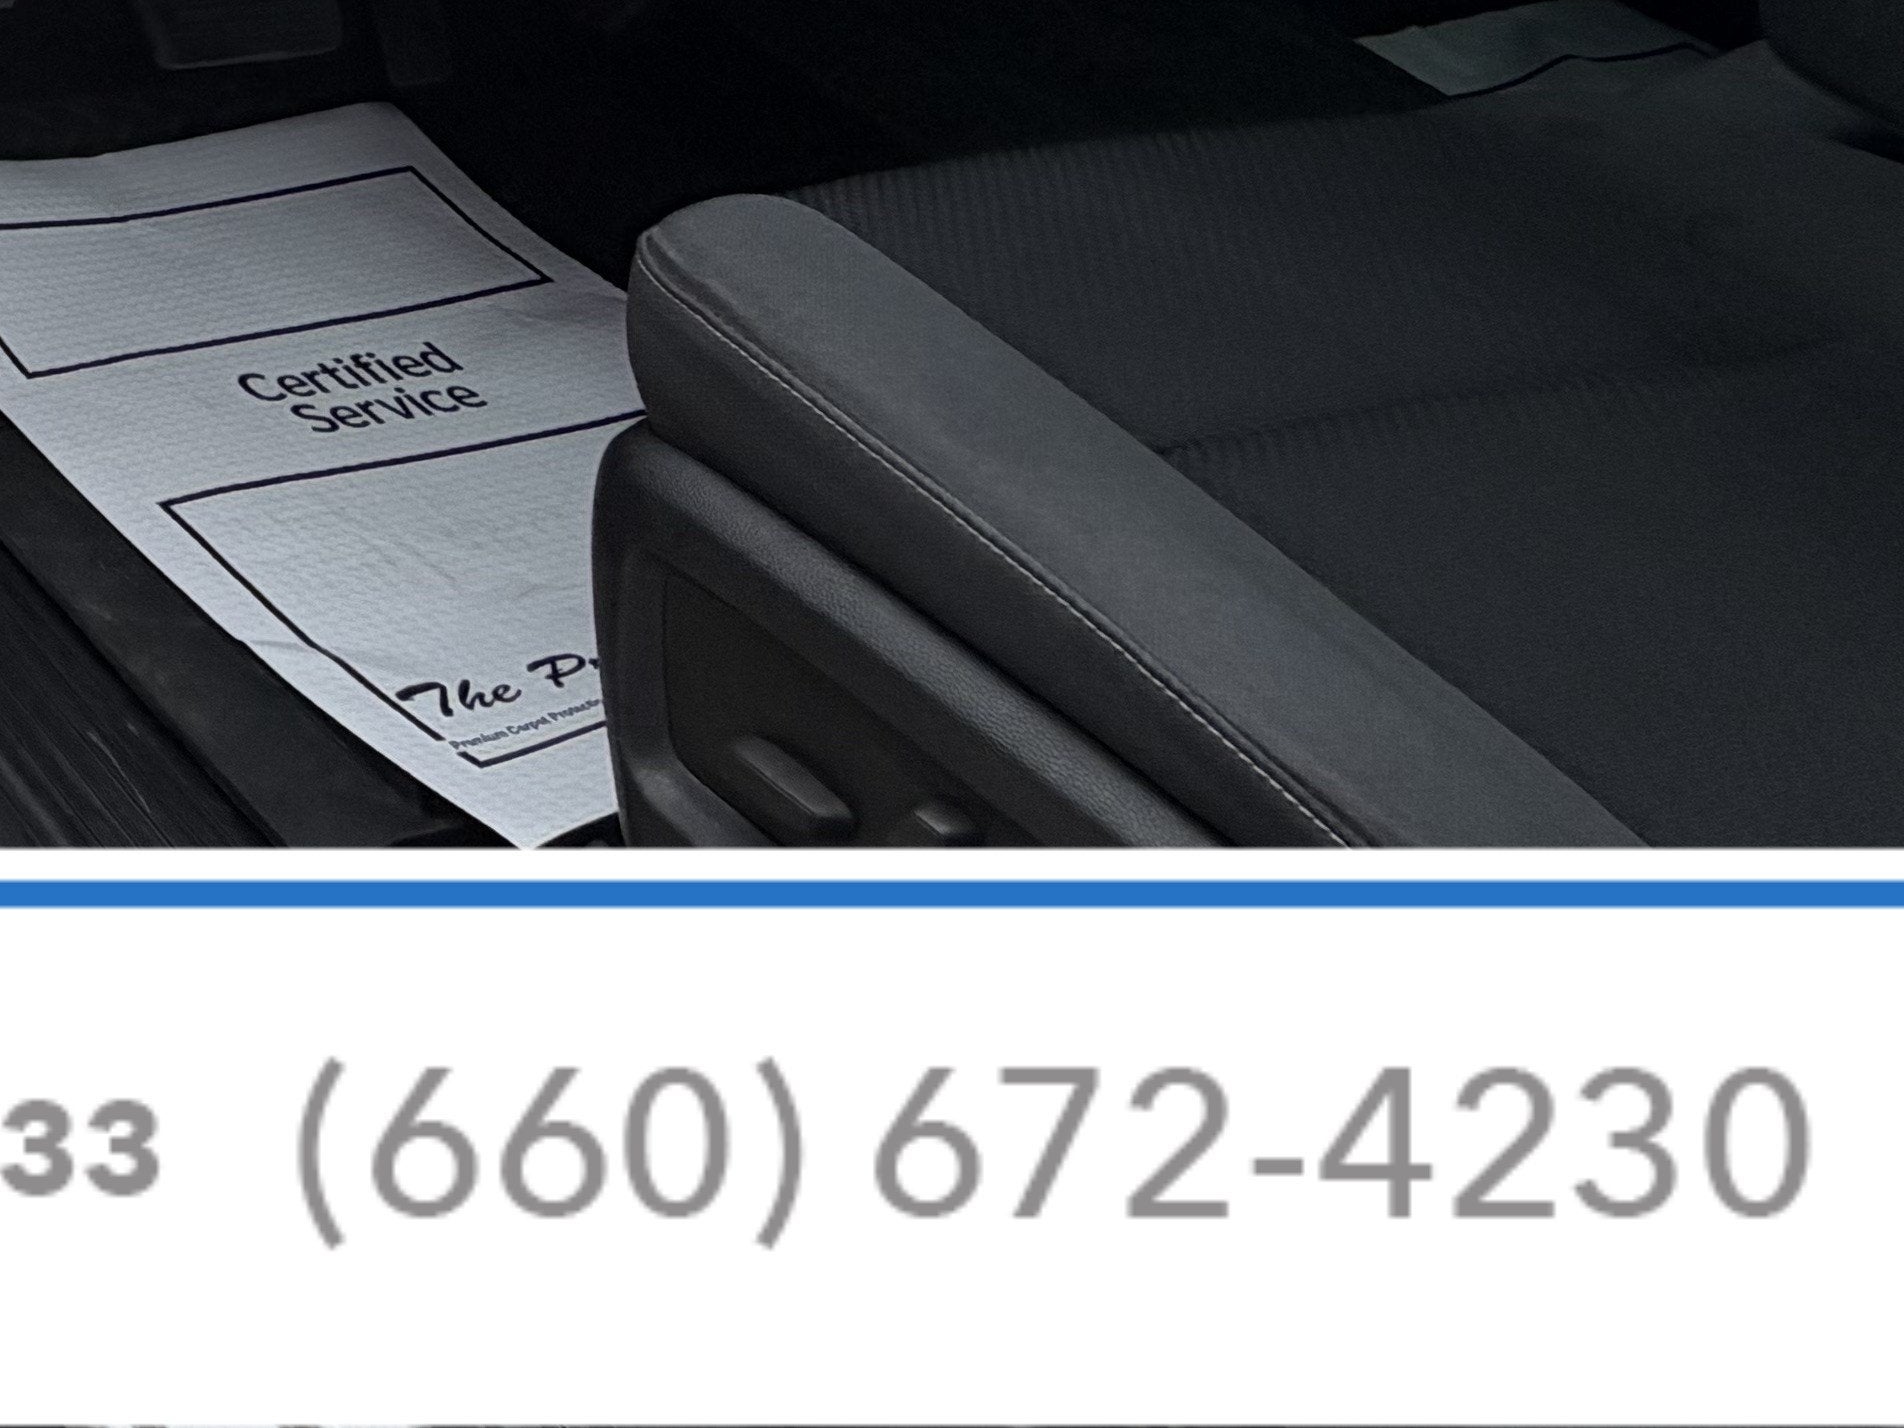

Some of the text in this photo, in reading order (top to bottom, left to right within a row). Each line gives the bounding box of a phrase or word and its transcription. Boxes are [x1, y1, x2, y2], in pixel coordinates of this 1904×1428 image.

[237, 341, 464, 402] Certified
[290, 386, 488, 433] Service
[394, 678, 522, 717] The
